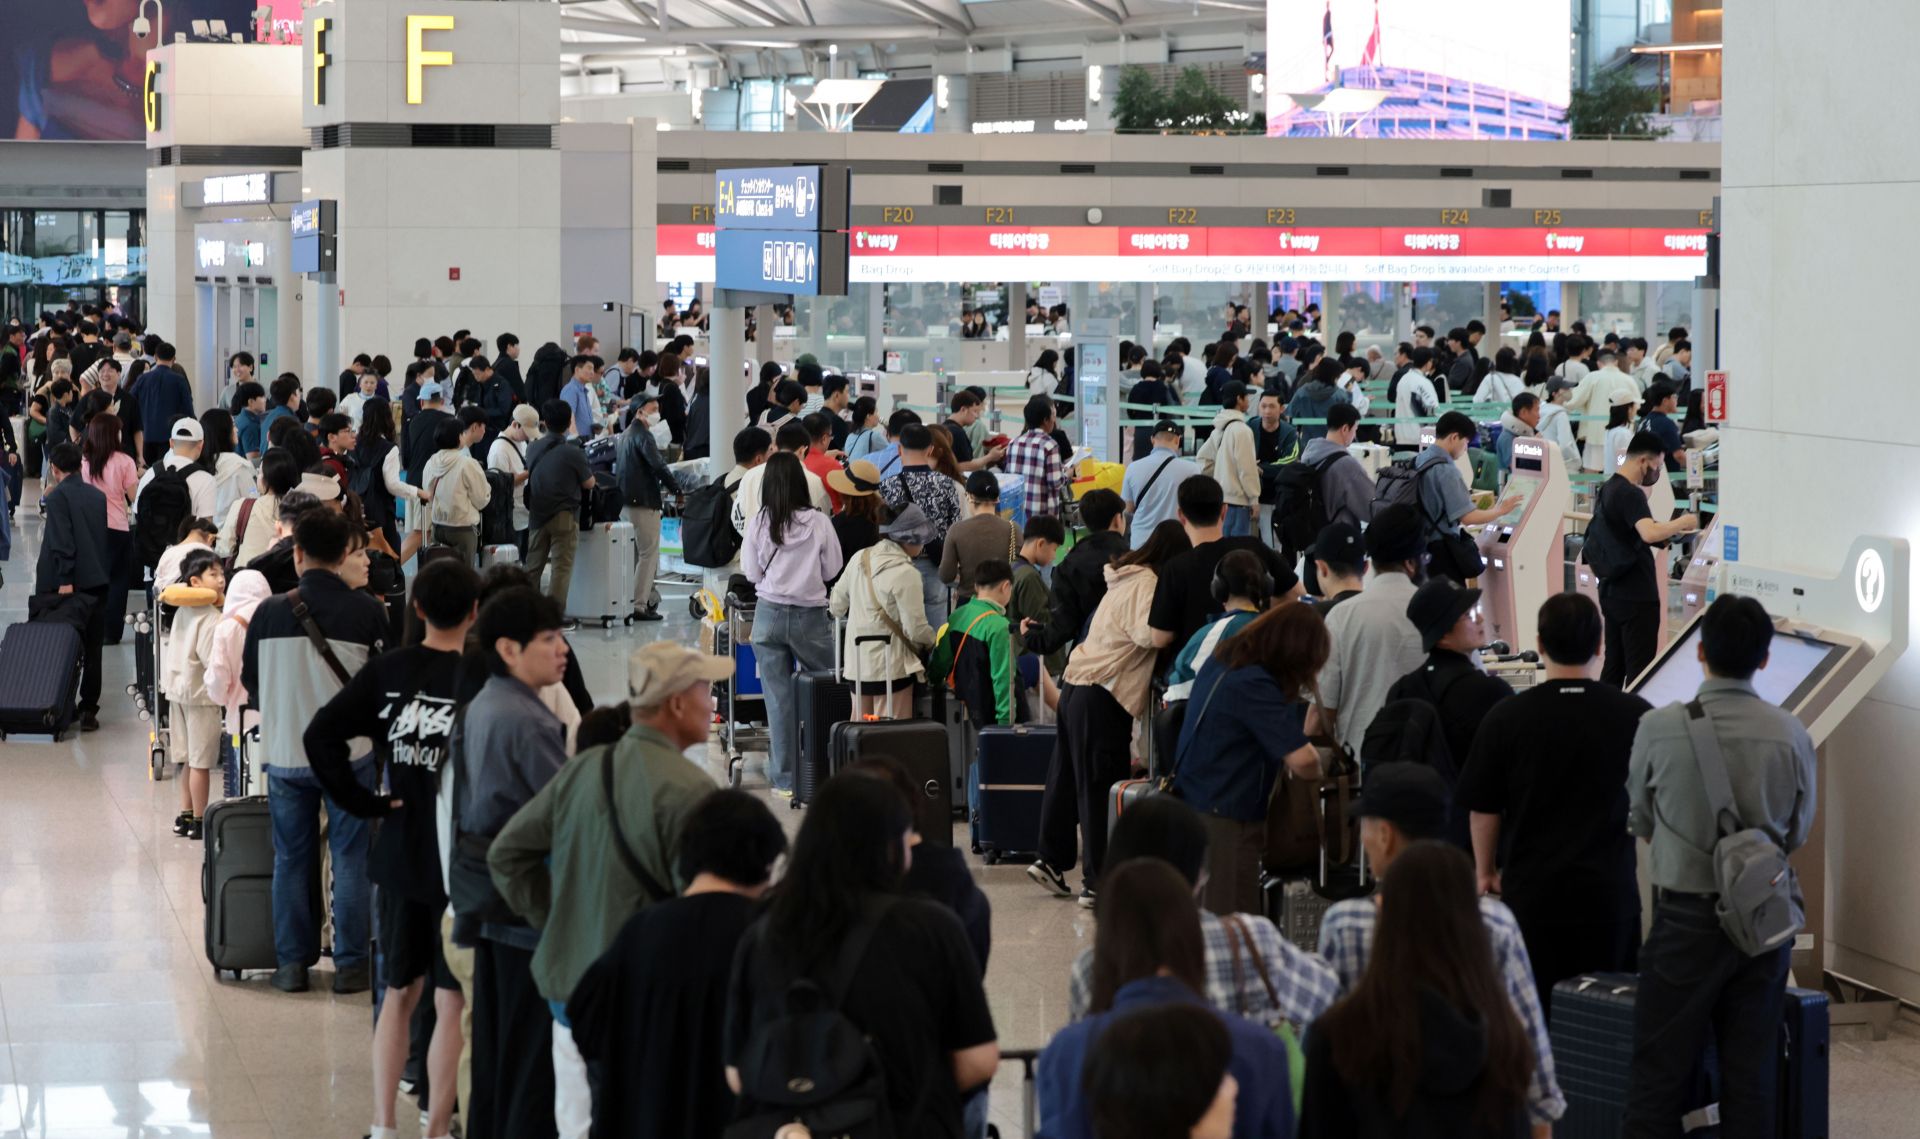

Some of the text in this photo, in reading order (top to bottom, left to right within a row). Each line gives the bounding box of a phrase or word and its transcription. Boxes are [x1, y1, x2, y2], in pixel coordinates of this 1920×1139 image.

[313, 18, 332, 106] F
[406, 15, 454, 104] F
[144, 60, 161, 132] G
[883, 207, 913, 223] F20
[986, 208, 1013, 224] F21
[1169, 208, 1197, 224] F22
[1267, 209, 1295, 224] F23
[1441, 210, 1469, 225] F24
[1534, 210, 1561, 225] F25
[1365, 264, 1384, 274] Self
[1388, 264, 1407, 275] Bag
[1410, 264, 1435, 274] Drop
[1449, 264, 1494, 273] available
[1497, 264, 1506, 273] at
[1509, 264, 1526, 273] the
[1529, 264, 1569, 273] Counter
